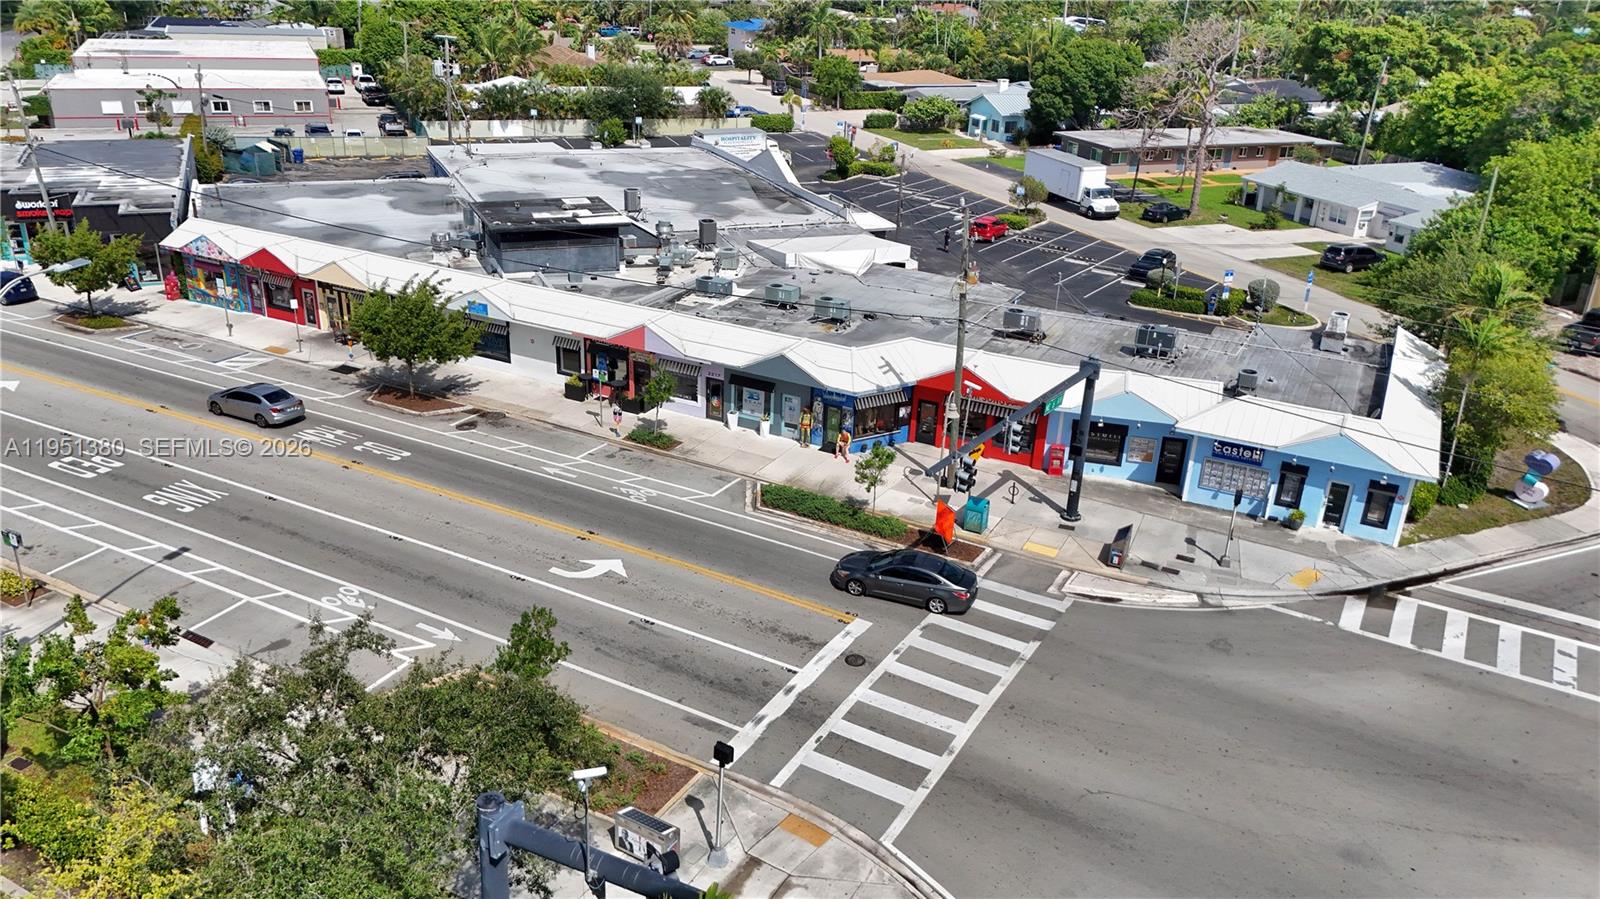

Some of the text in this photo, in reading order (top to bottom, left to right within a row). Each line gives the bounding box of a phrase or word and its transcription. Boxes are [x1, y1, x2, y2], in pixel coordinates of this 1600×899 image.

[292, 424, 364, 448] MPH
[352, 441, 412, 461] 30
[47, 450, 126, 479] PED
[141, 479, 230, 513] XING
